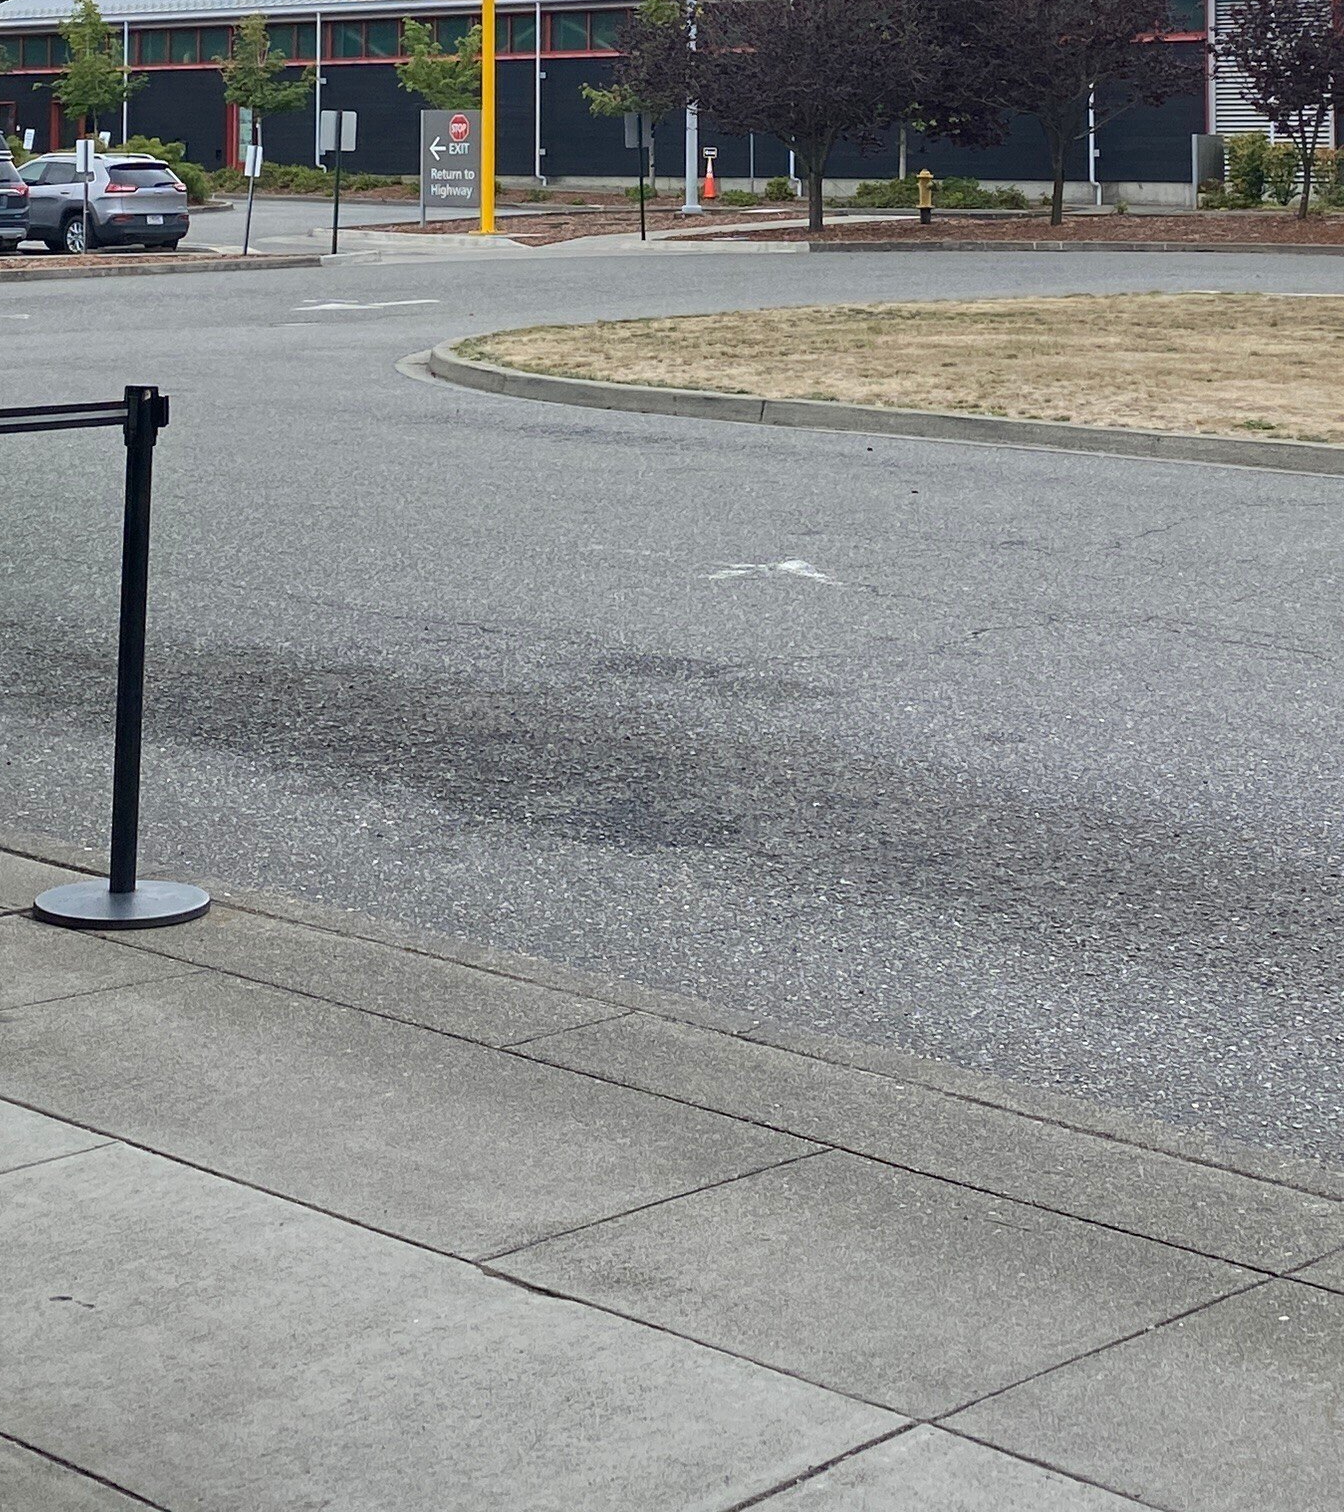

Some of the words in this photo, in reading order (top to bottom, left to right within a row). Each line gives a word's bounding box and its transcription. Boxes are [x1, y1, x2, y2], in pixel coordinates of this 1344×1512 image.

[451, 123, 467, 133] STOP
[449, 143, 469, 155] EXIT
[430, 168, 463, 180] Return
[464, 169, 475, 180] to
[430, 184, 473, 199] Highway
